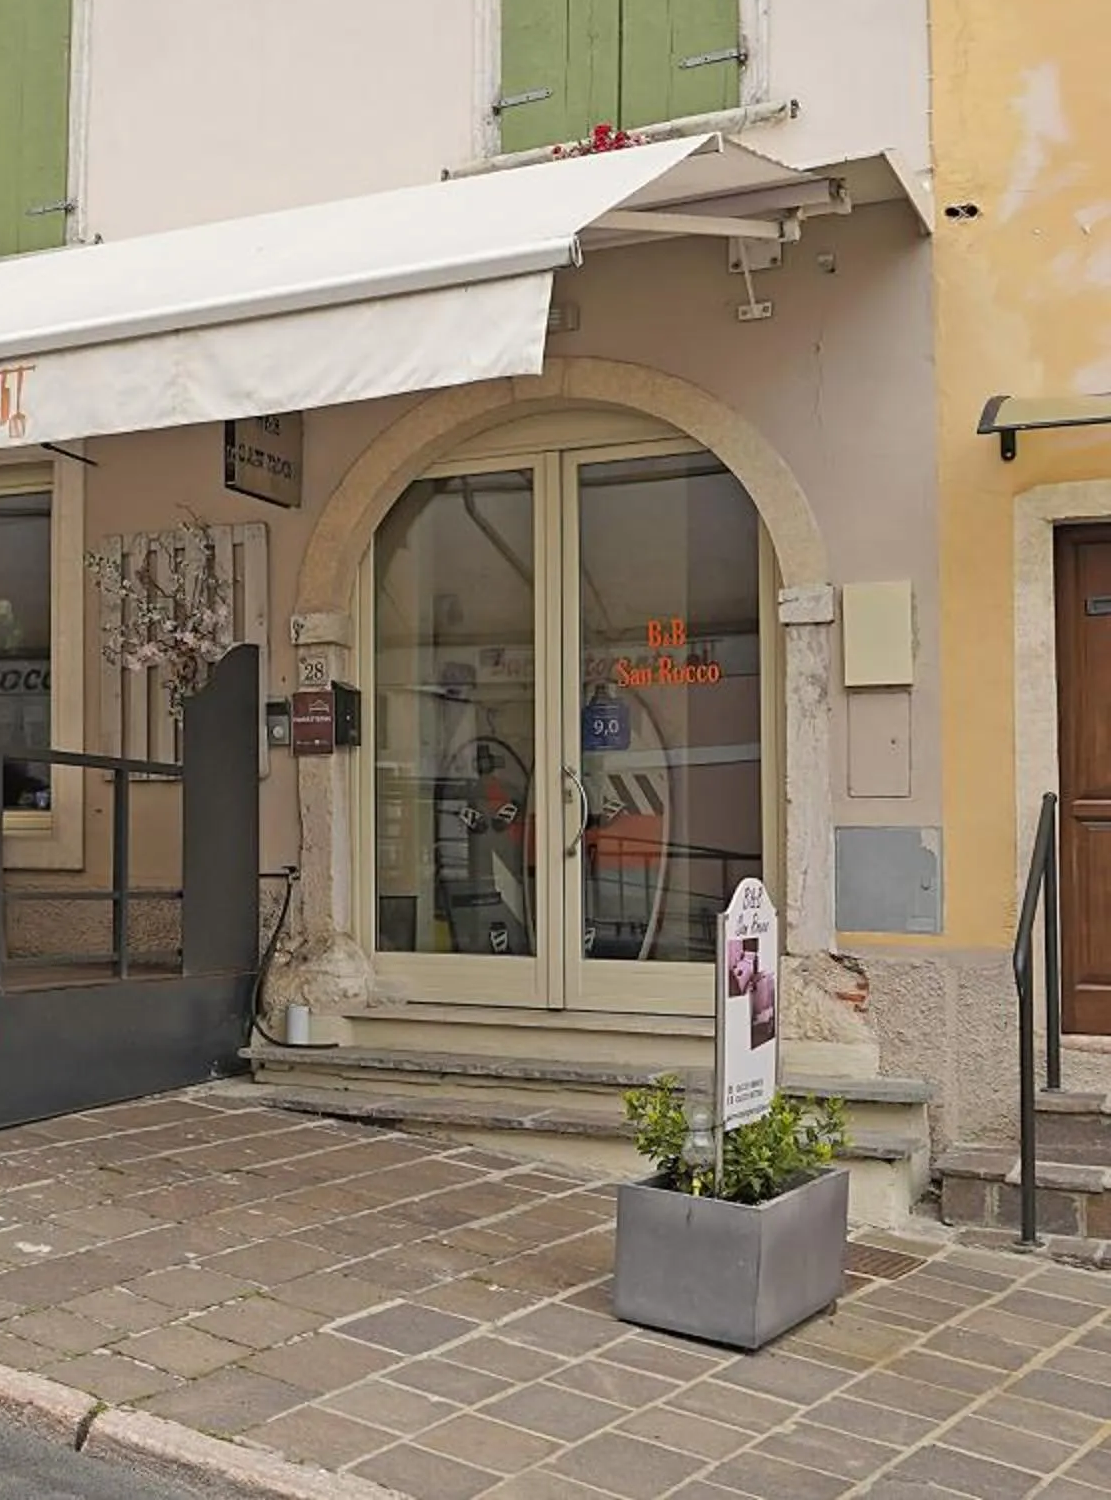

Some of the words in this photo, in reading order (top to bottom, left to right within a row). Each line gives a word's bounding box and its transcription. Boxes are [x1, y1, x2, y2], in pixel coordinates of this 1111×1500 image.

[646, 617, 687, 649] B&B
[304, 661, 324, 681] 28
[614, 657, 653, 688] San
[657, 653, 721, 687] Rocco
[593, 719, 620, 737] 9,0
